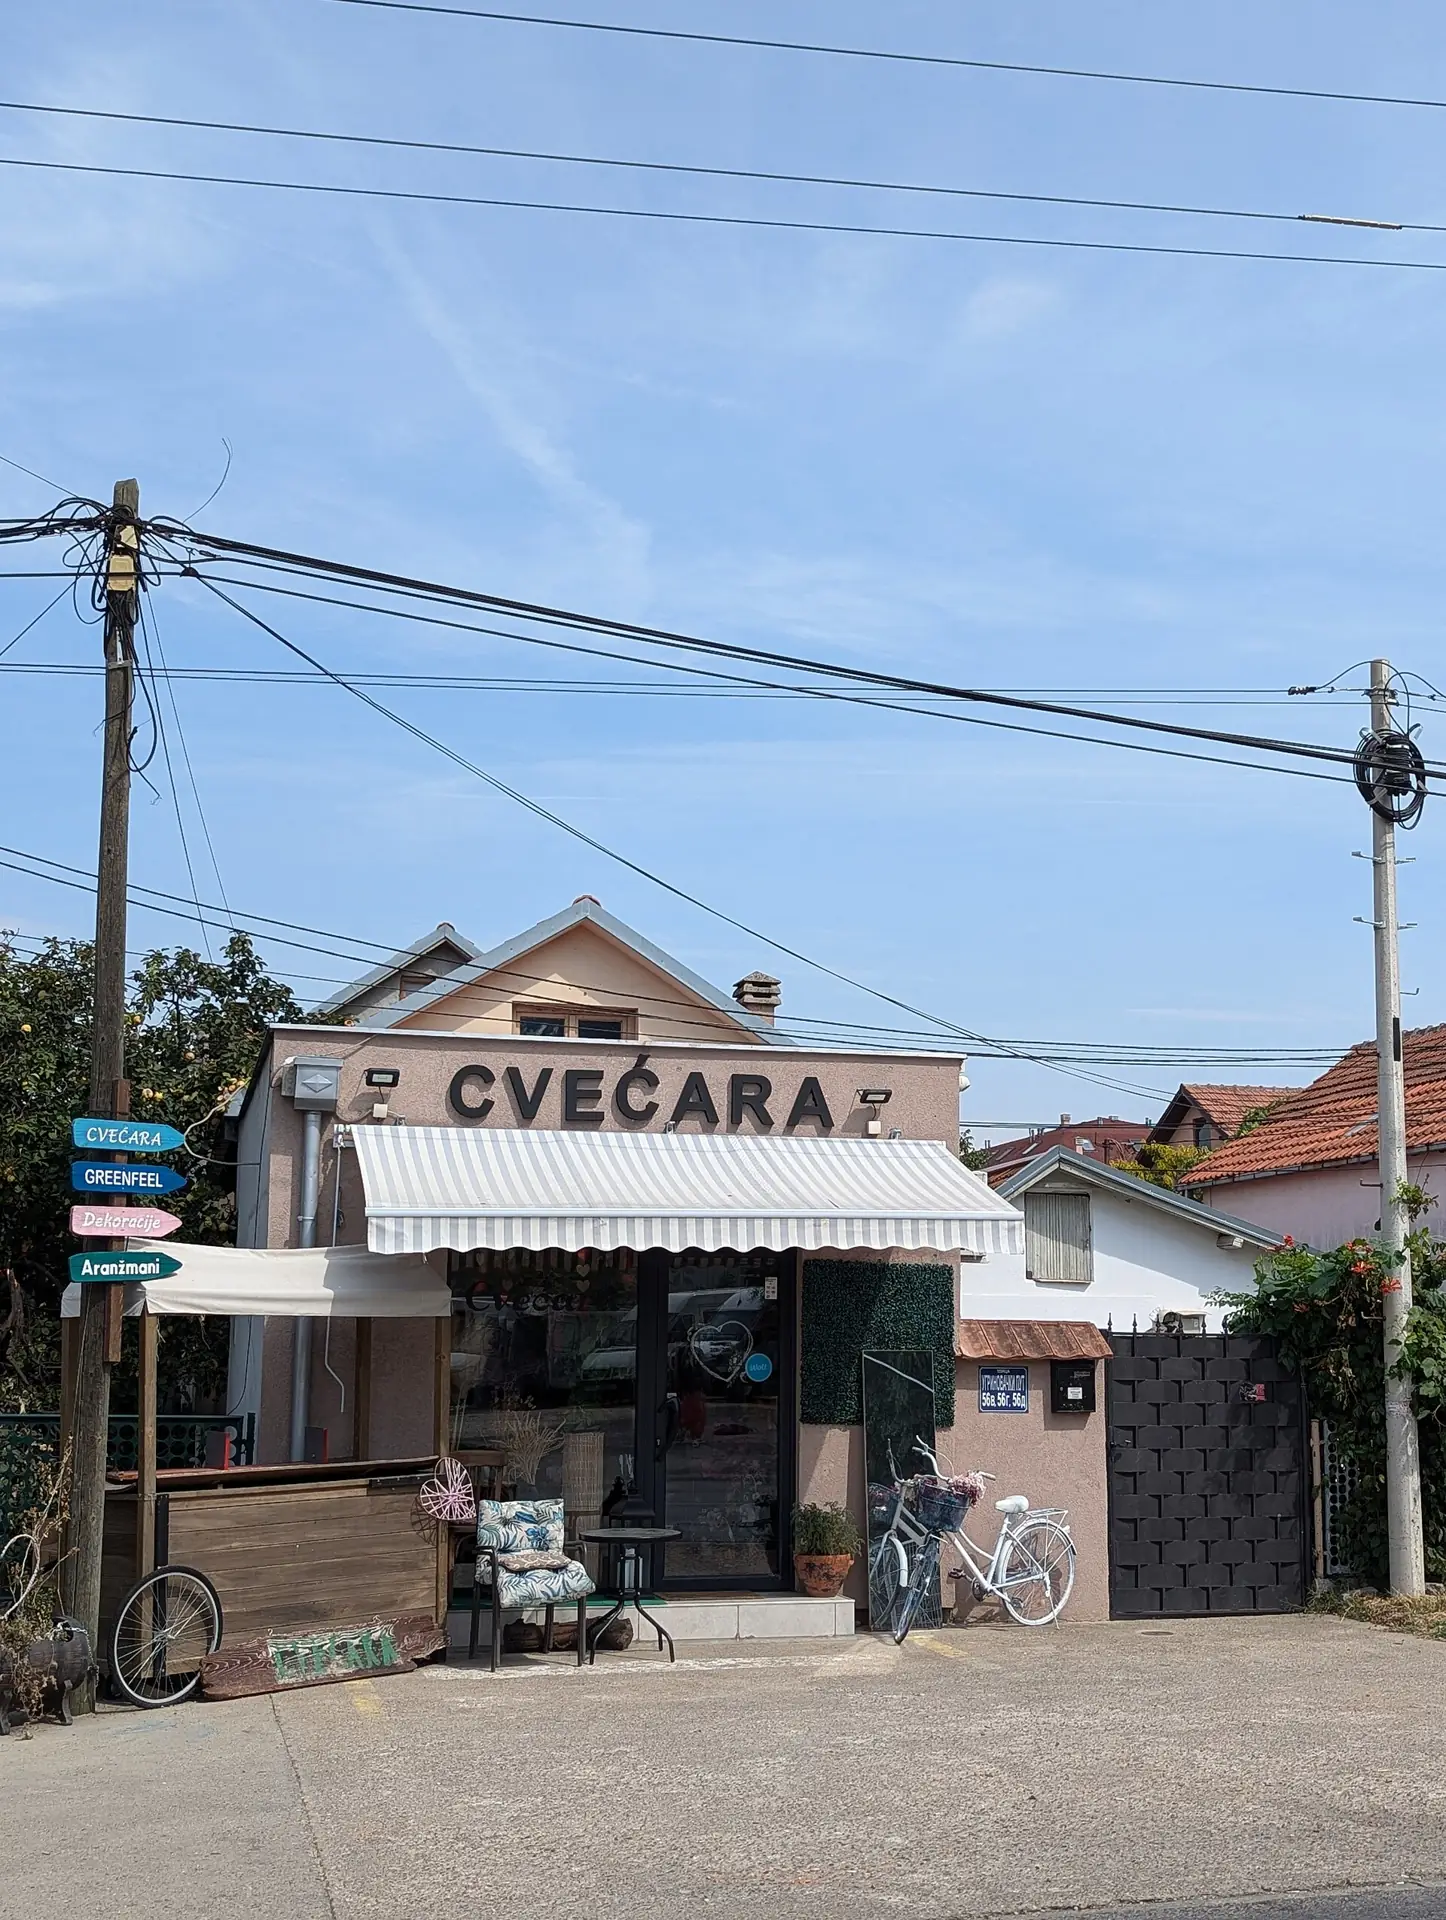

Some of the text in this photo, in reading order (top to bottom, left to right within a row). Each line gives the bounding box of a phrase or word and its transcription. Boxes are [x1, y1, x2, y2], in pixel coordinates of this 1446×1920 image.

[449, 1054, 834, 1127] CVEĆARA
[86, 1127, 161, 1146] CVEĆARA
[85, 1169, 163, 1187] GREENFEEL
[82, 1212, 161, 1232] Dekoracije
[81, 1258, 160, 1276] Aranžmani
[1012, 1392, 1026, 1409] 56д
